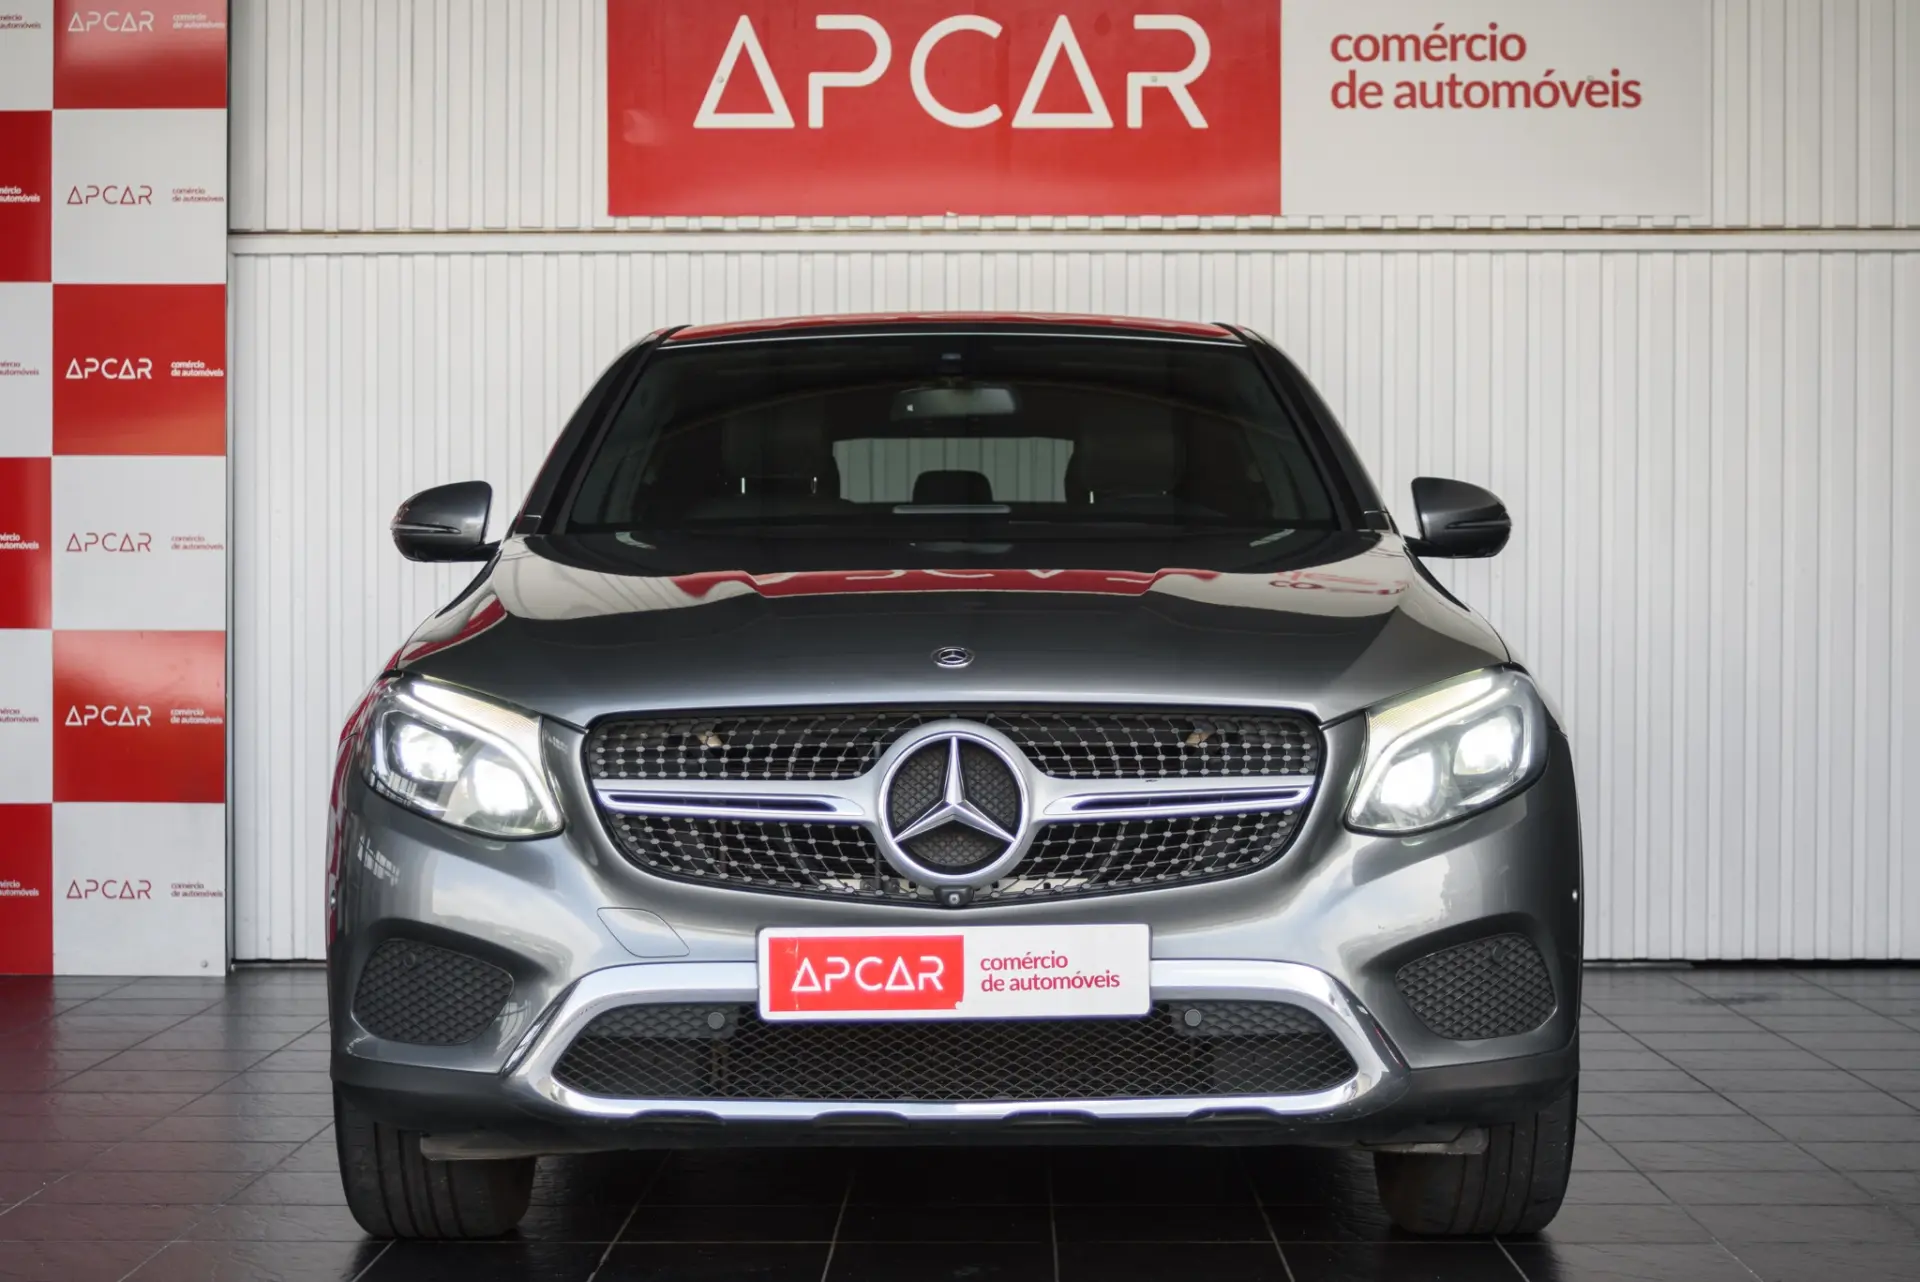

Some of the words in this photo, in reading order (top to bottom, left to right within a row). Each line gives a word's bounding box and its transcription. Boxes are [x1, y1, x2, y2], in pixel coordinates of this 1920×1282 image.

[68, 11, 154, 32] APCAR
[1330, 22, 1527, 62] comércio
[693, 12, 1211, 130] APCAR
[1330, 69, 1384, 109] de
[1393, 68, 1642, 109] automóveis
[67, 185, 153, 205] APCAR
[65, 357, 153, 379] APCAR
[66, 532, 152, 552] APCAR
[65, 705, 152, 727] APCAR
[66, 879, 152, 899] APCAR
[980, 950, 1068, 973] comércio
[790, 955, 945, 993] APCAR
[980, 974, 1005, 993] de
[1010, 970, 1121, 991] automóveis
